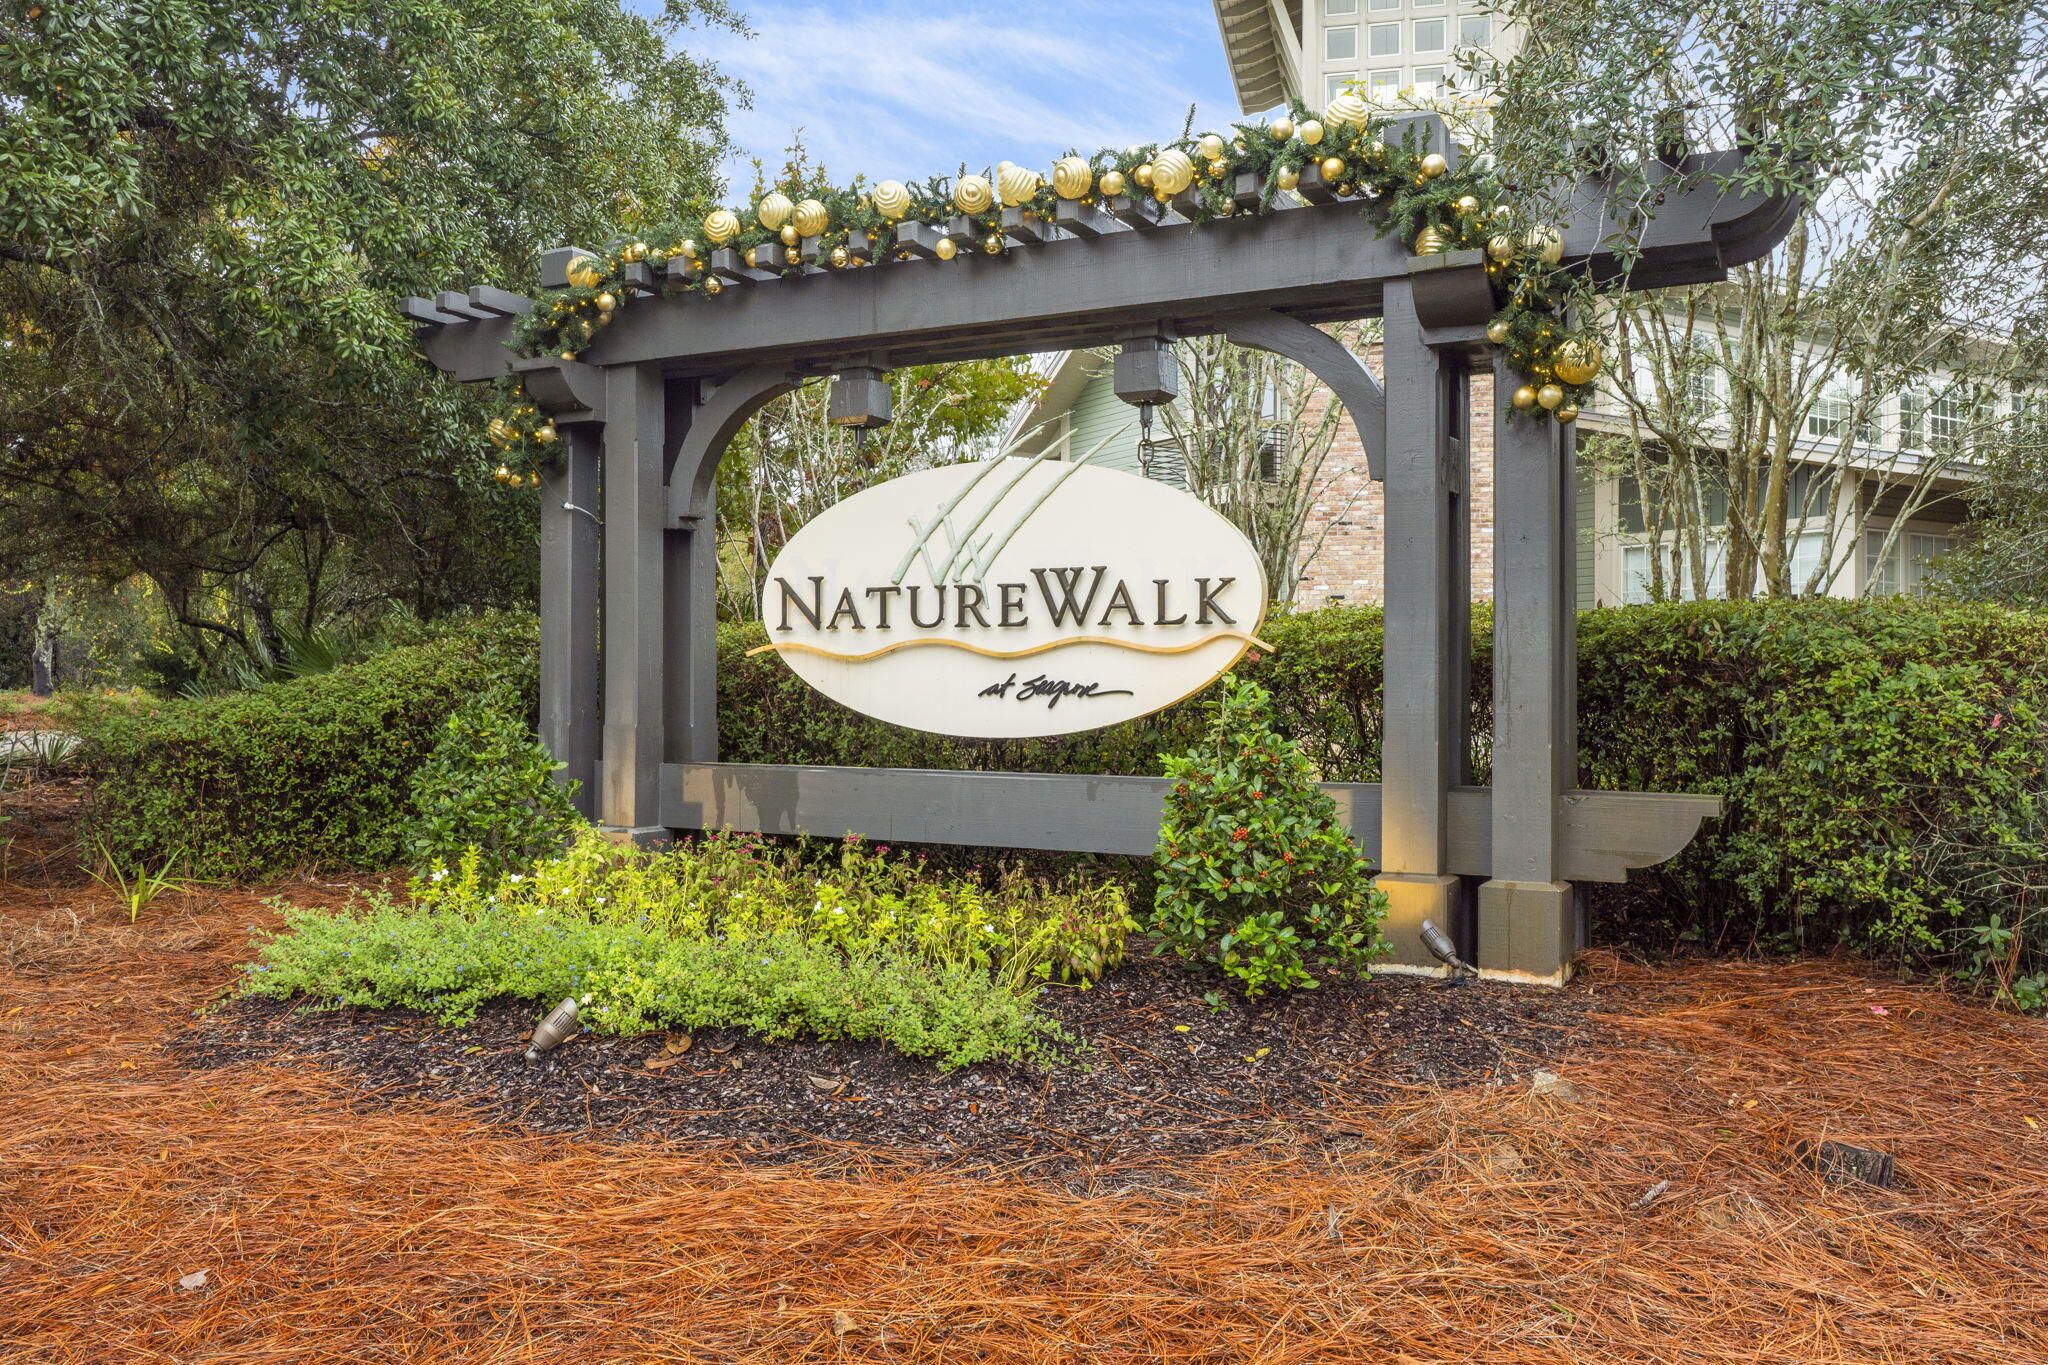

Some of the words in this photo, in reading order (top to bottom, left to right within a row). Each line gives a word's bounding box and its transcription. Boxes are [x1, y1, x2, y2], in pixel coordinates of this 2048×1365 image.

[774, 566, 1237, 631] NATUREWALK
[978, 673, 1016, 698] at
[1016, 674, 1134, 709] Seagrove
